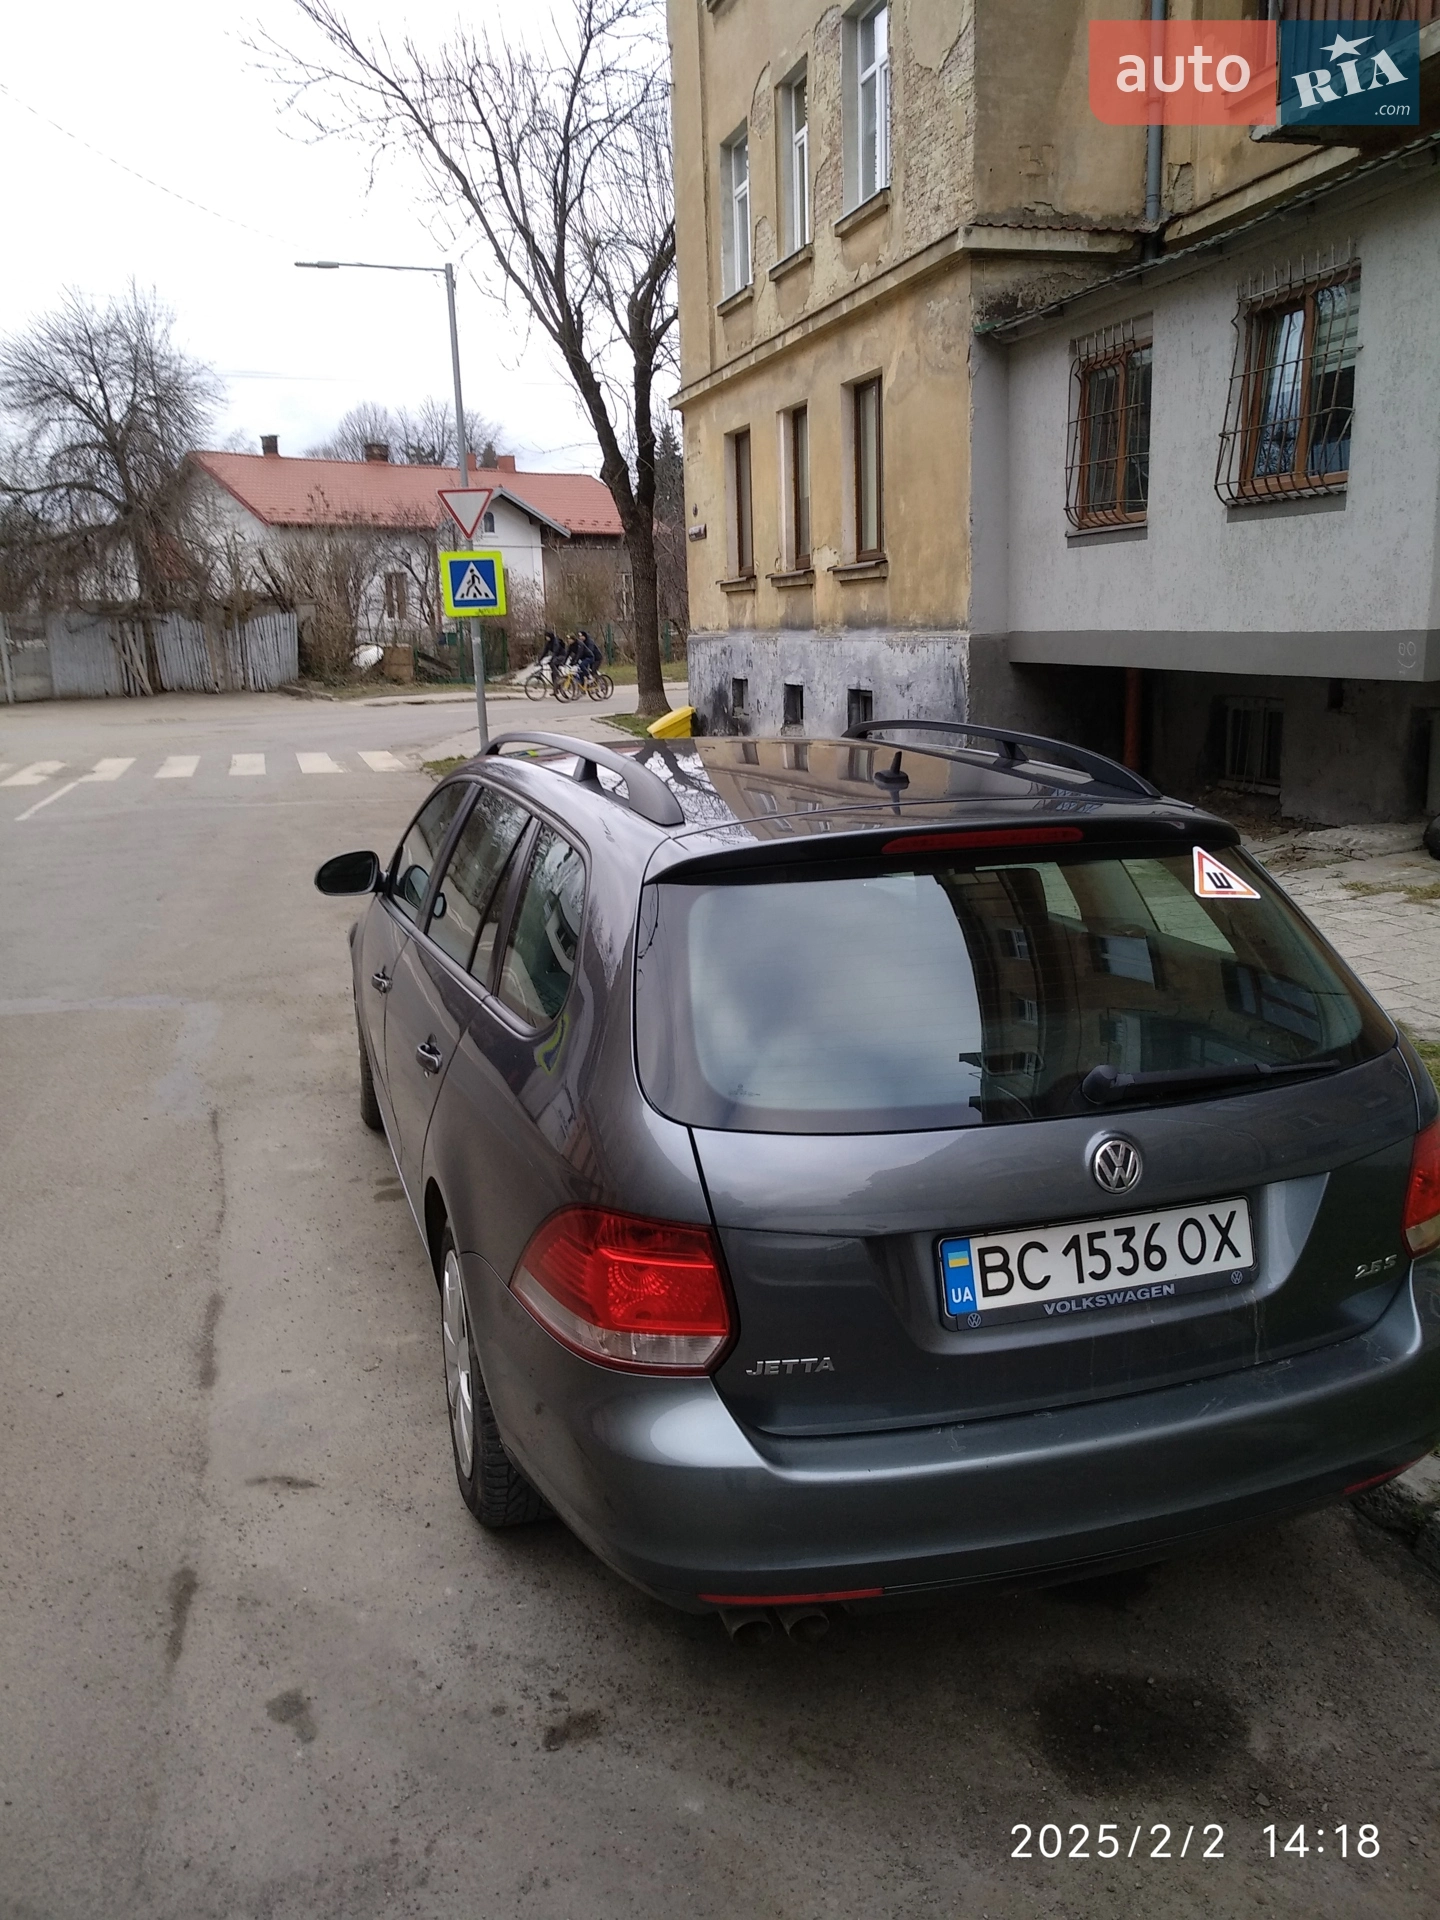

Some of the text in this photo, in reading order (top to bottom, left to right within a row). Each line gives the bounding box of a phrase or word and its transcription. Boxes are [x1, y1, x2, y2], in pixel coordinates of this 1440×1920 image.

[977, 1210, 1242, 1298] BC 1536 OX
[951, 1286, 973, 1304] UA
[1043, 1283, 1176, 1316] VOLKSWAGEN
[745, 1356, 835, 1376] JETTA
